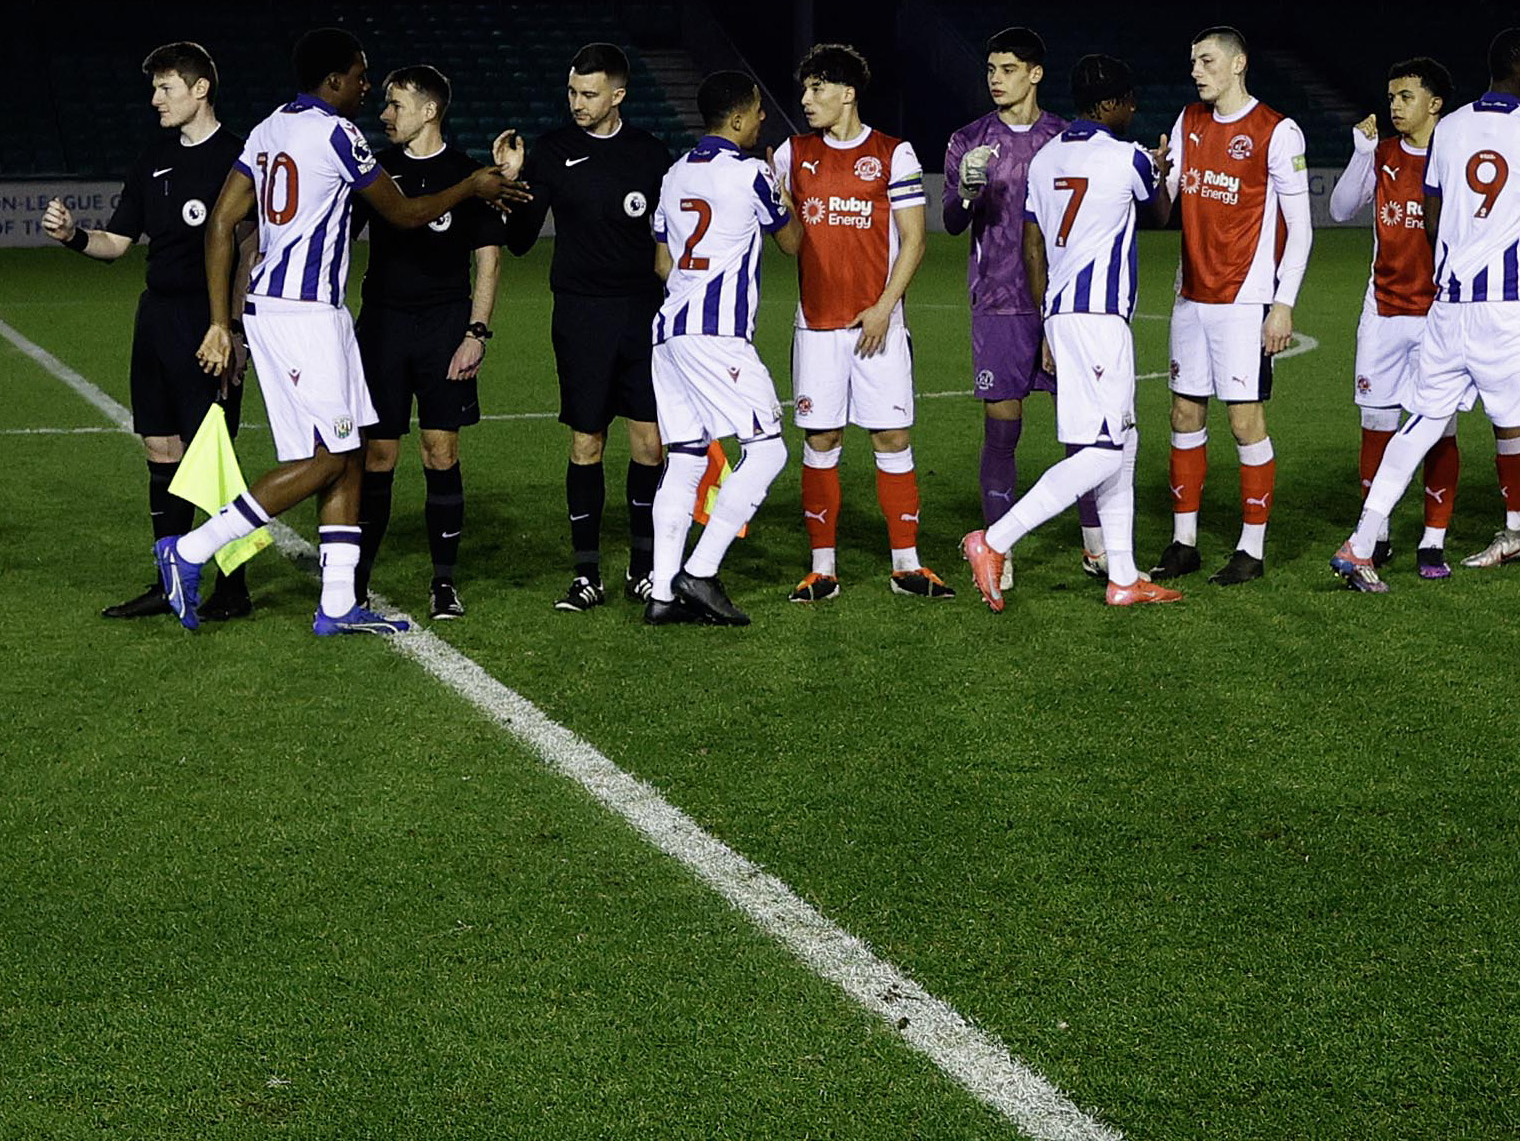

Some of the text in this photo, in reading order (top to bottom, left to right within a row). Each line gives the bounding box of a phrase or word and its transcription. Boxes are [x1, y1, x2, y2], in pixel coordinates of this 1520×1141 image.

[256, 152, 299, 226] 10
[1203, 170, 1240, 192] Ruby
[1466, 150, 1509, 218] 9
[0, 194, 105, 212] N-LEGUE
[829, 197, 872, 216] Ruby
[1201, 186, 1238, 205] Energy
[828, 213, 872, 229] Energy
[1053, 177, 1089, 247] 7
[678, 198, 712, 270] 2
